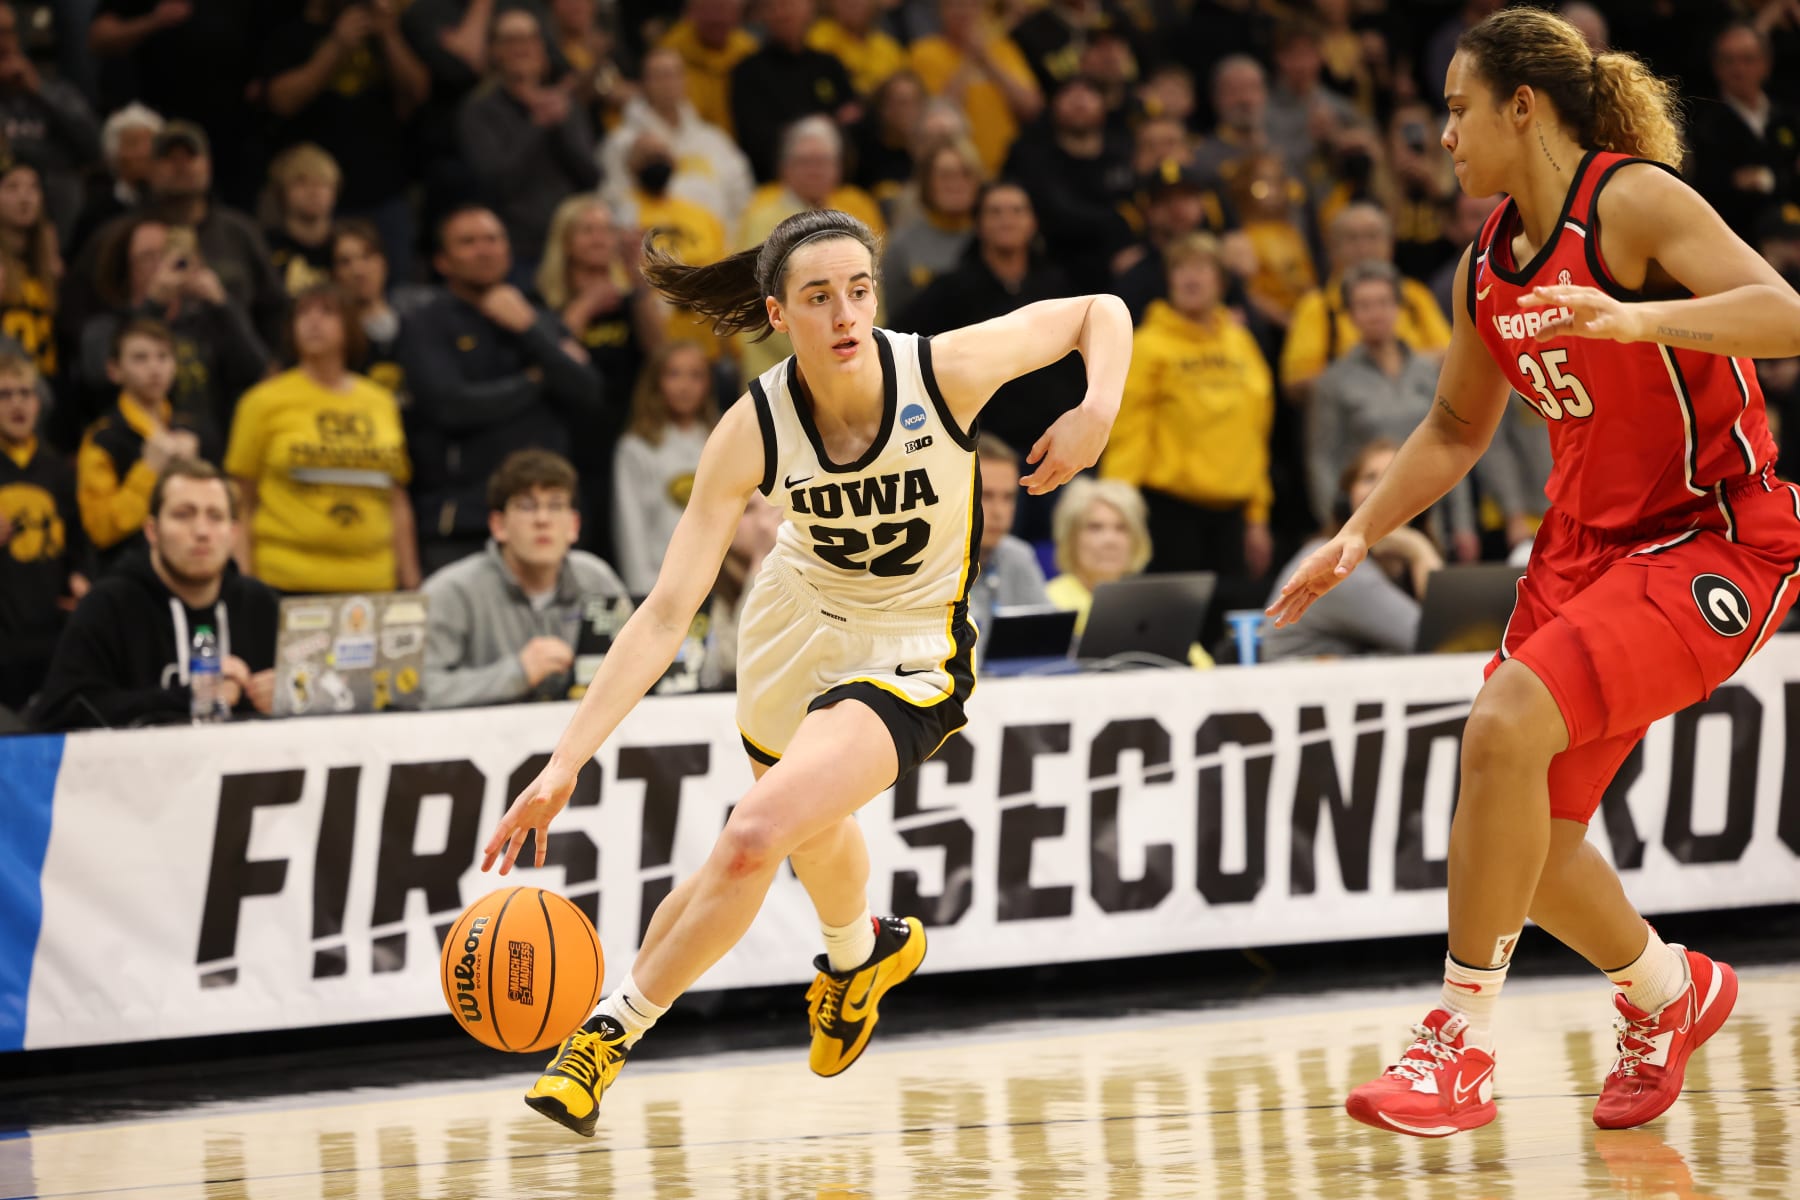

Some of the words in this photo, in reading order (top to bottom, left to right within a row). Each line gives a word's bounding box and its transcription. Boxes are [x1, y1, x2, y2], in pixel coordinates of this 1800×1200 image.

[1517, 347, 1594, 421] 35
[904, 413, 926, 428] NCAA
[790, 467, 939, 520] IOWA
[809, 517, 931, 578] 22
[195, 742, 711, 990] FIRST
[890, 699, 1476, 928] SECOND
[454, 915, 491, 1023] Wilson
[509, 957, 521, 992] MARCH
[520, 942, 531, 988] MADNESS
